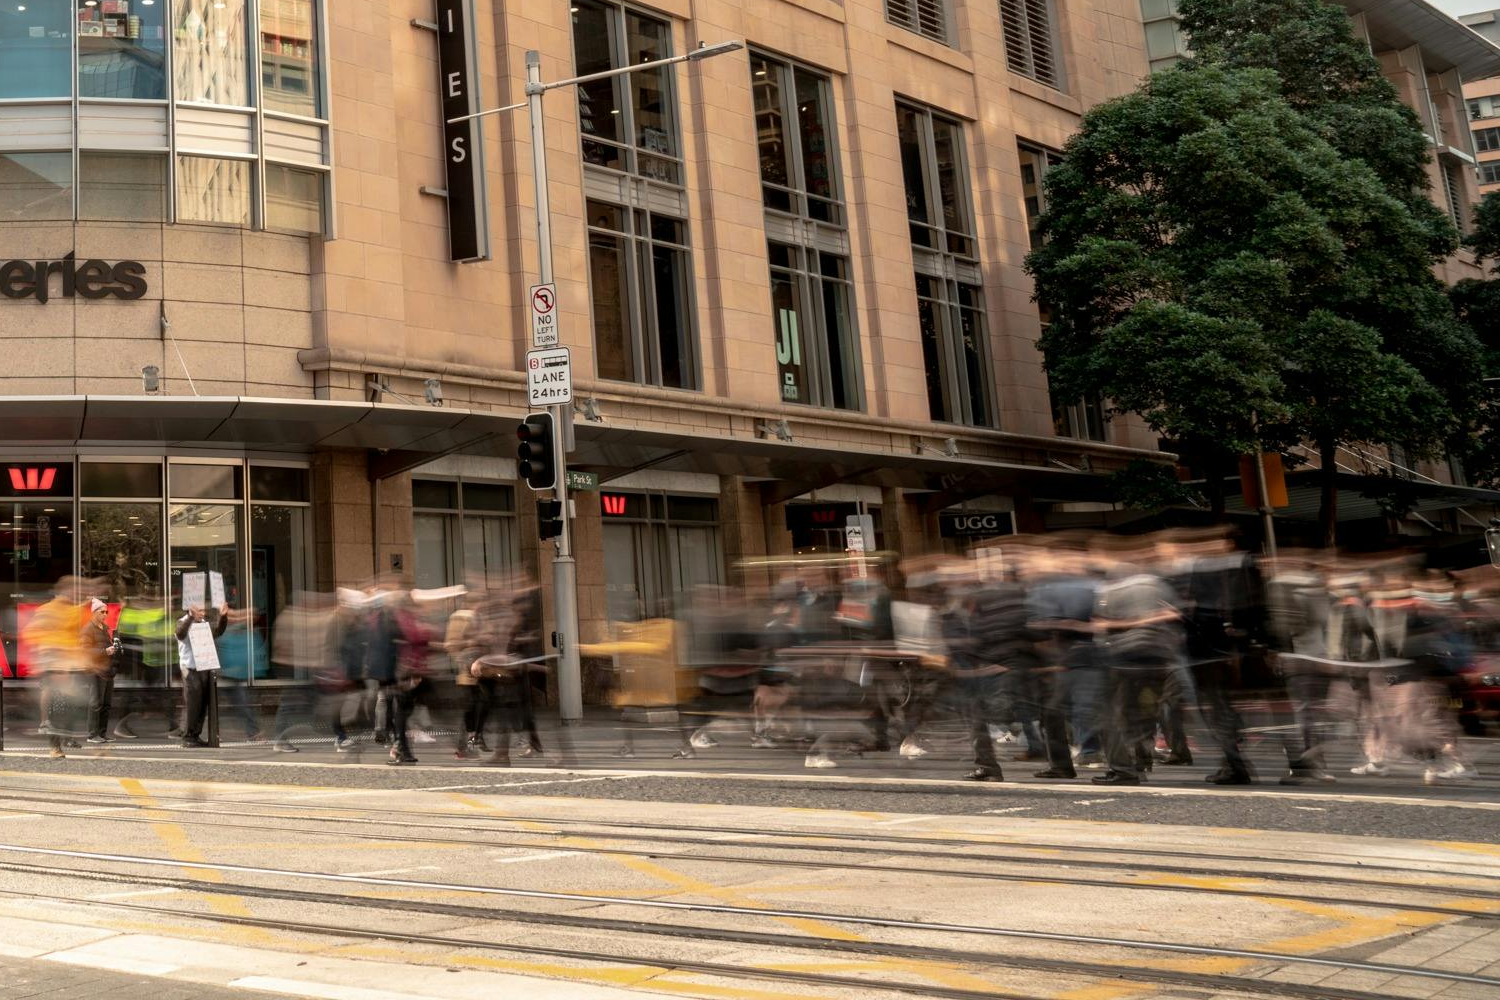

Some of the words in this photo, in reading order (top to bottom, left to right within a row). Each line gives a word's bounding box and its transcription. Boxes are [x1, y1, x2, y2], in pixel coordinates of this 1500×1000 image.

[537, 315, 552, 325] NO
[536, 325, 555, 335] LEFT
[537, 335, 556, 343] TURN
[533, 371, 566, 384] LANE
[532, 388, 569, 399] 24hrs
[573, 474, 586, 484] Park
[953, 515, 998, 530] UGG
